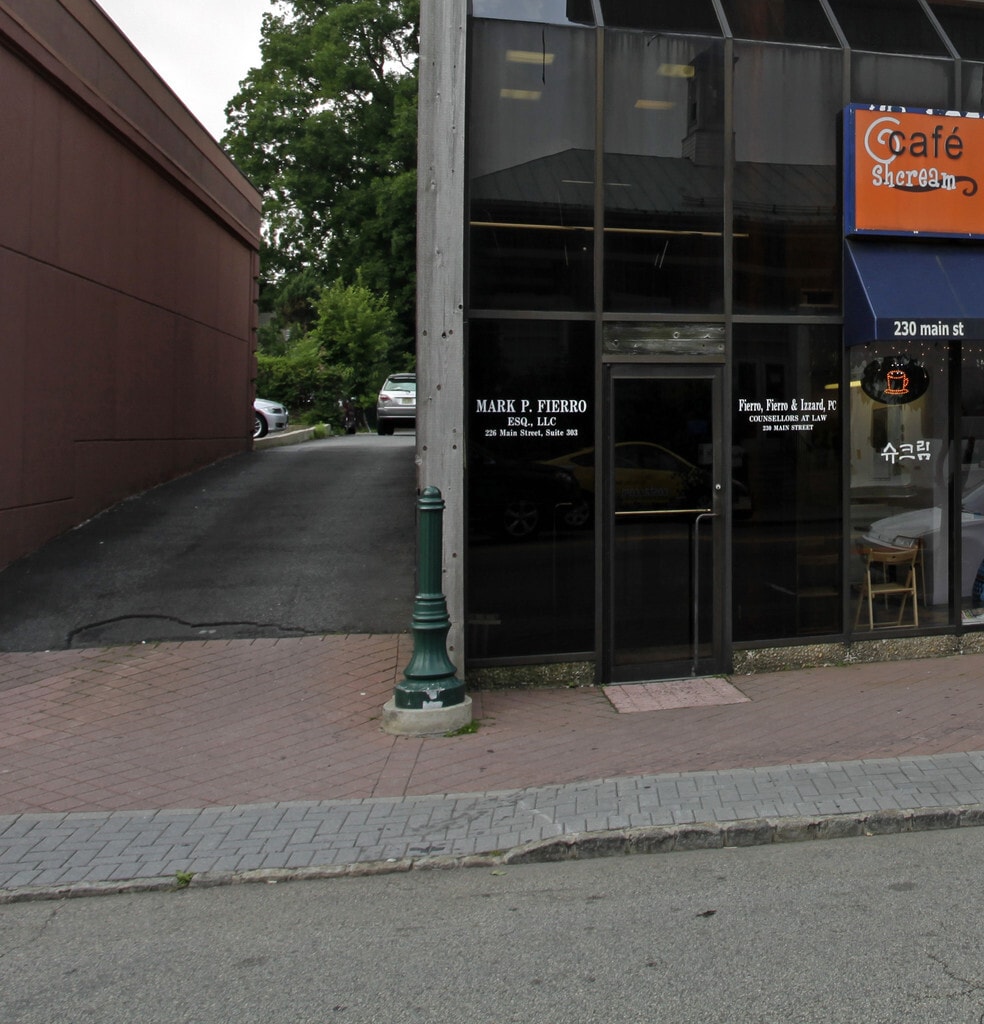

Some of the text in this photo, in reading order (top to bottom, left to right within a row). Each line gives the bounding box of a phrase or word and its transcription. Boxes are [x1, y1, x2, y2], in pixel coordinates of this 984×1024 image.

[888, 125, 964, 160] café
[893, 320, 964, 336] 230 main st
[476, 399, 587, 413] MARK P. FIERRO
[738, 398, 837, 413] Fierro, Fierro & Izzard, PC
[507, 416, 557, 427] ESQ., LLC
[748, 414, 828, 423] COUNSELLORS AT LAW
[484, 429, 578, 437] 226 Main Street, Suite 303
[773, 424, 790, 432] MAIN
[880, 440, 931, 464] 슈크림
